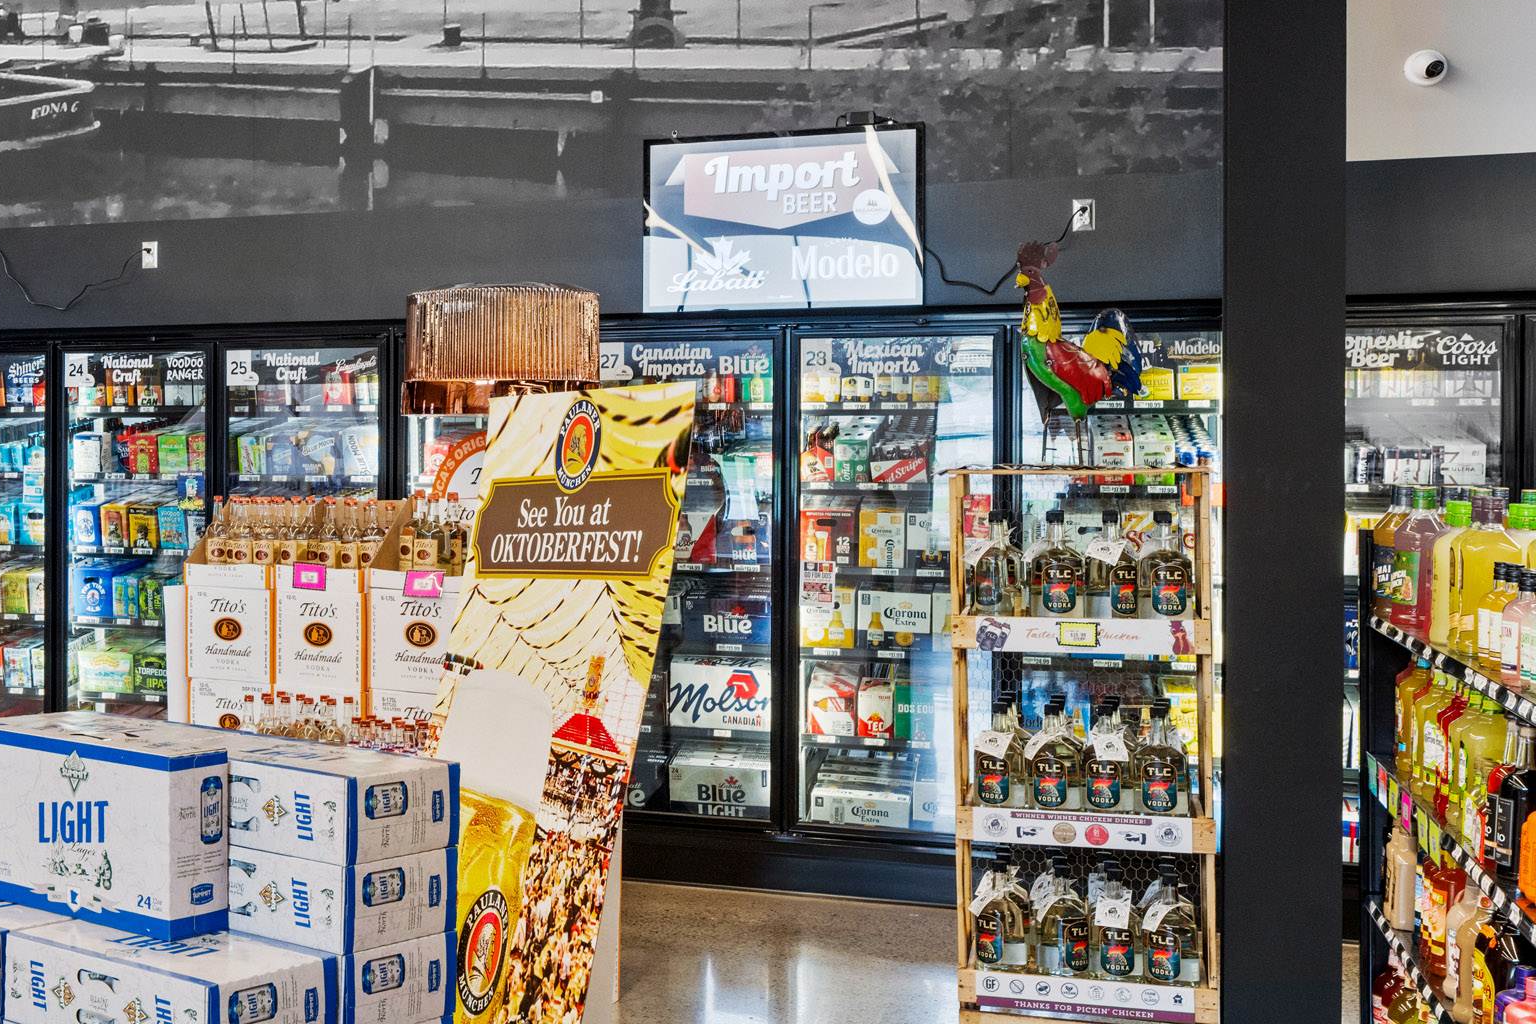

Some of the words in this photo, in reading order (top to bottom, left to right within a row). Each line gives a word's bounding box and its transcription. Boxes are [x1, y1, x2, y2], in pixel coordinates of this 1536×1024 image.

[30, 102, 68, 120] EDNA
[704, 151, 862, 201] Import
[782, 191, 838, 215] BEER
[792, 244, 900, 281] Modelo
[666, 268, 769, 294] Labatt
[1173, 340, 1220, 355] Modelo
[1345, 329, 1430, 350] omestic
[1436, 334, 1498, 355] Coors
[631, 344, 712, 363] Canadian
[843, 340, 924, 358] Mexican
[100, 354, 154, 369] National
[166, 356, 203, 369] VOODOO
[264, 352, 321, 367] National
[600, 353, 619, 369] 27
[718, 355, 771, 376] Blue
[806, 351, 826, 366] 28
[1346, 349, 1400, 368] Beer
[1442, 354, 1491, 365] LIGHT
[8, 361, 44, 377] Shiner
[69, 363, 84, 376] 24
[166, 368, 203, 380] RANGER
[230, 360, 248, 375] 25
[276, 366, 308, 382] Craft
[638, 359, 705, 379] Imports
[846, 357, 920, 377] Imports
[12, 376, 40, 384] BEERS
[112, 369, 142, 384] Craft
[560, 400, 601, 437] PAULANER
[892, 456, 924, 479] Stripe
[517, 498, 548, 529] See
[554, 496, 584, 527] You
[590, 498, 612, 526] at
[136, 539, 149, 548] IPA
[490, 530, 643, 564] OKTOBERFEST!
[1048, 569, 1072, 580] TLC
[1157, 570, 1183, 581] TLC
[210, 597, 247, 615] Tito's
[399, 600, 442, 618] Tito's
[883, 605, 928, 620] Corona
[1047, 601, 1072, 610] VODKA
[1157, 603, 1183, 612] VODKA
[704, 614, 752, 634] Blue
[894, 616, 917, 627] Extra
[205, 643, 252, 659] Handmade
[897, 703, 915, 714] DOS
[722, 716, 761, 727] CANADIAN
[697, 783, 746, 804] Blue
[38, 799, 109, 845] LIGHT
[293, 791, 314, 843] LIGHT
[1047, 813, 1077, 821] WINNER
[1079, 815, 1113, 823] CHICKEN
[1115, 817, 1147, 825] DINNER!
[67, 840, 99, 858] Lager
[137, 894, 151, 910] 24
[292, 877, 312, 929] LIGHT
[985, 978, 997, 990] GF
[1014, 1000, 1051, 1010] THANKS
[1054, 1003, 1073, 1012] FOR
[1112, 1008, 1154, 1019] CHICKEN
